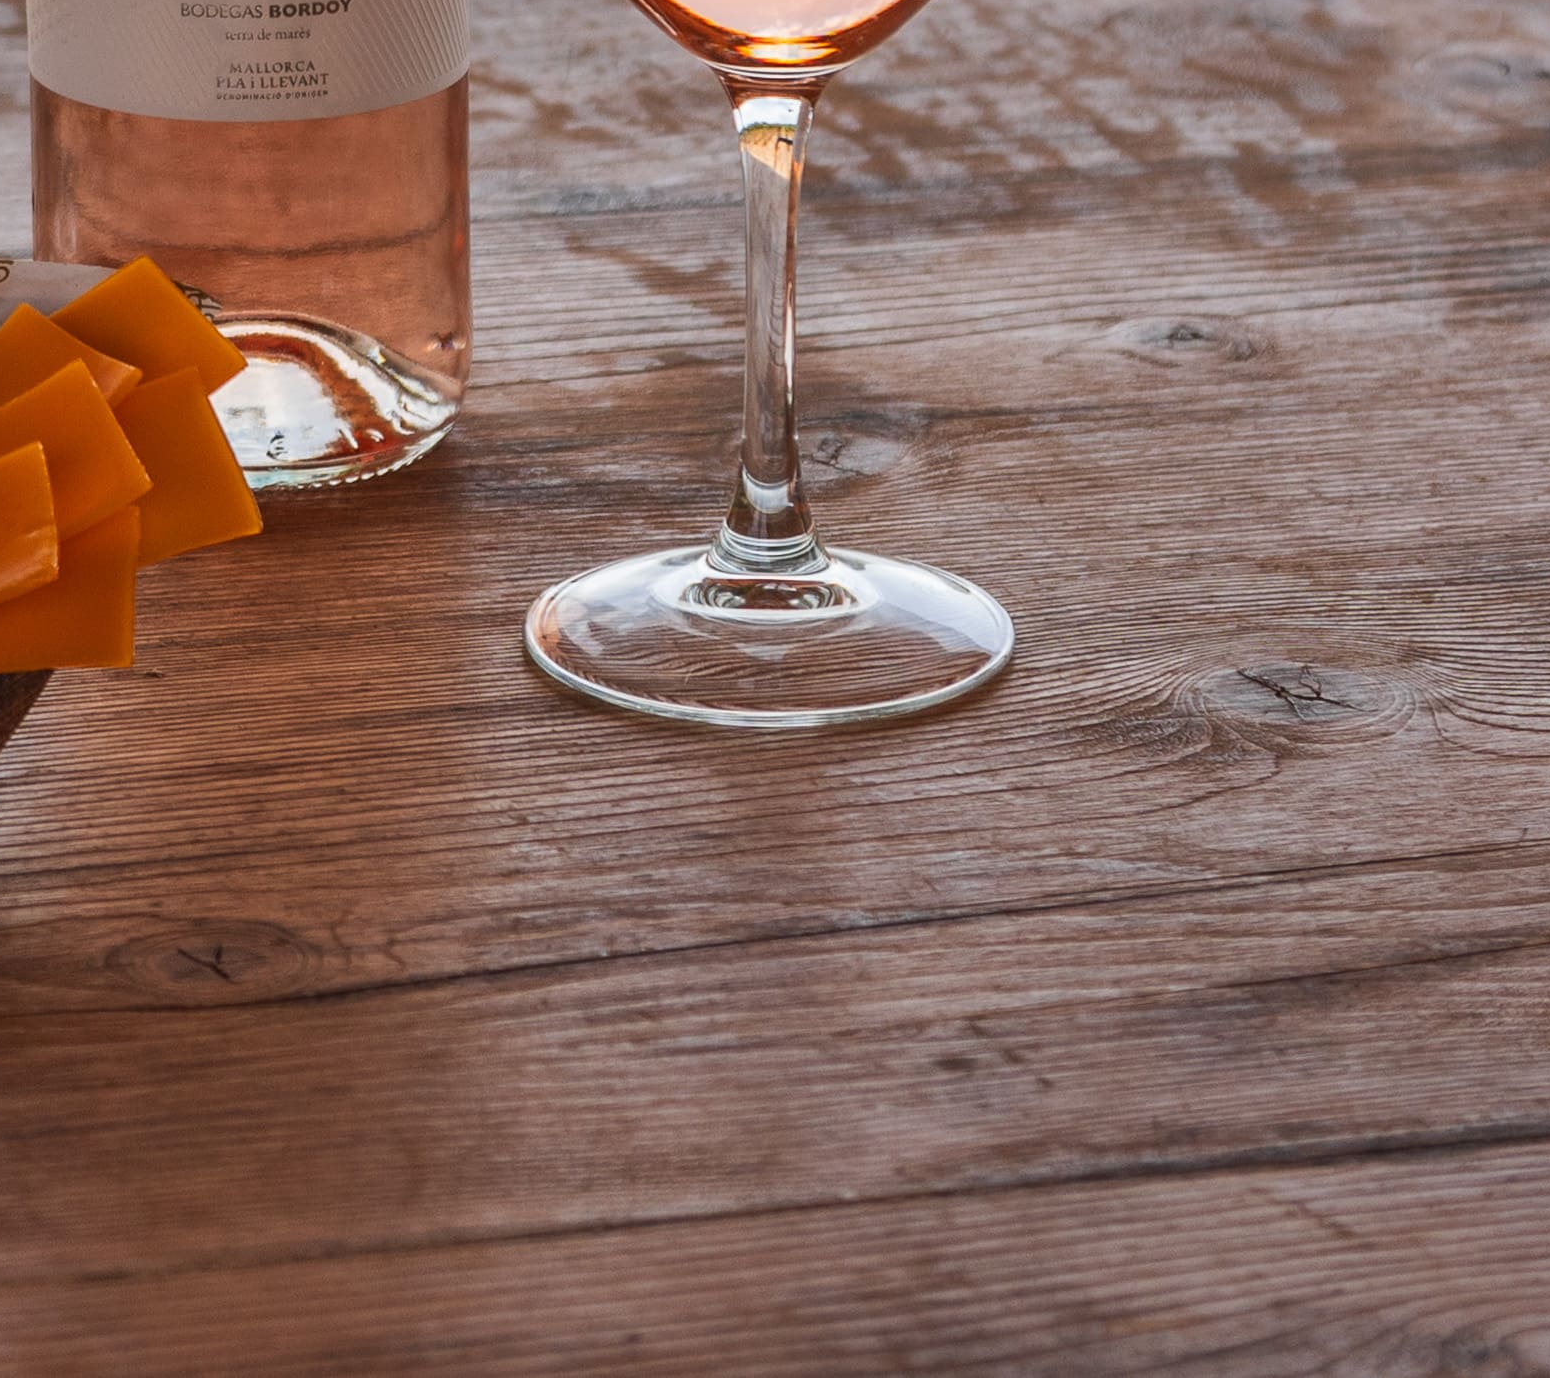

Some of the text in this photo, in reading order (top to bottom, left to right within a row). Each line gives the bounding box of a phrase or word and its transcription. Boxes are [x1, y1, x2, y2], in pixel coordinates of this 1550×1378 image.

[180, 2, 263, 19] BODEGAS
[225, 26, 311, 41] terra de marès
[229, 60, 316, 74] MALLORCA
[216, 73, 330, 89] PLA i LLEVANT
